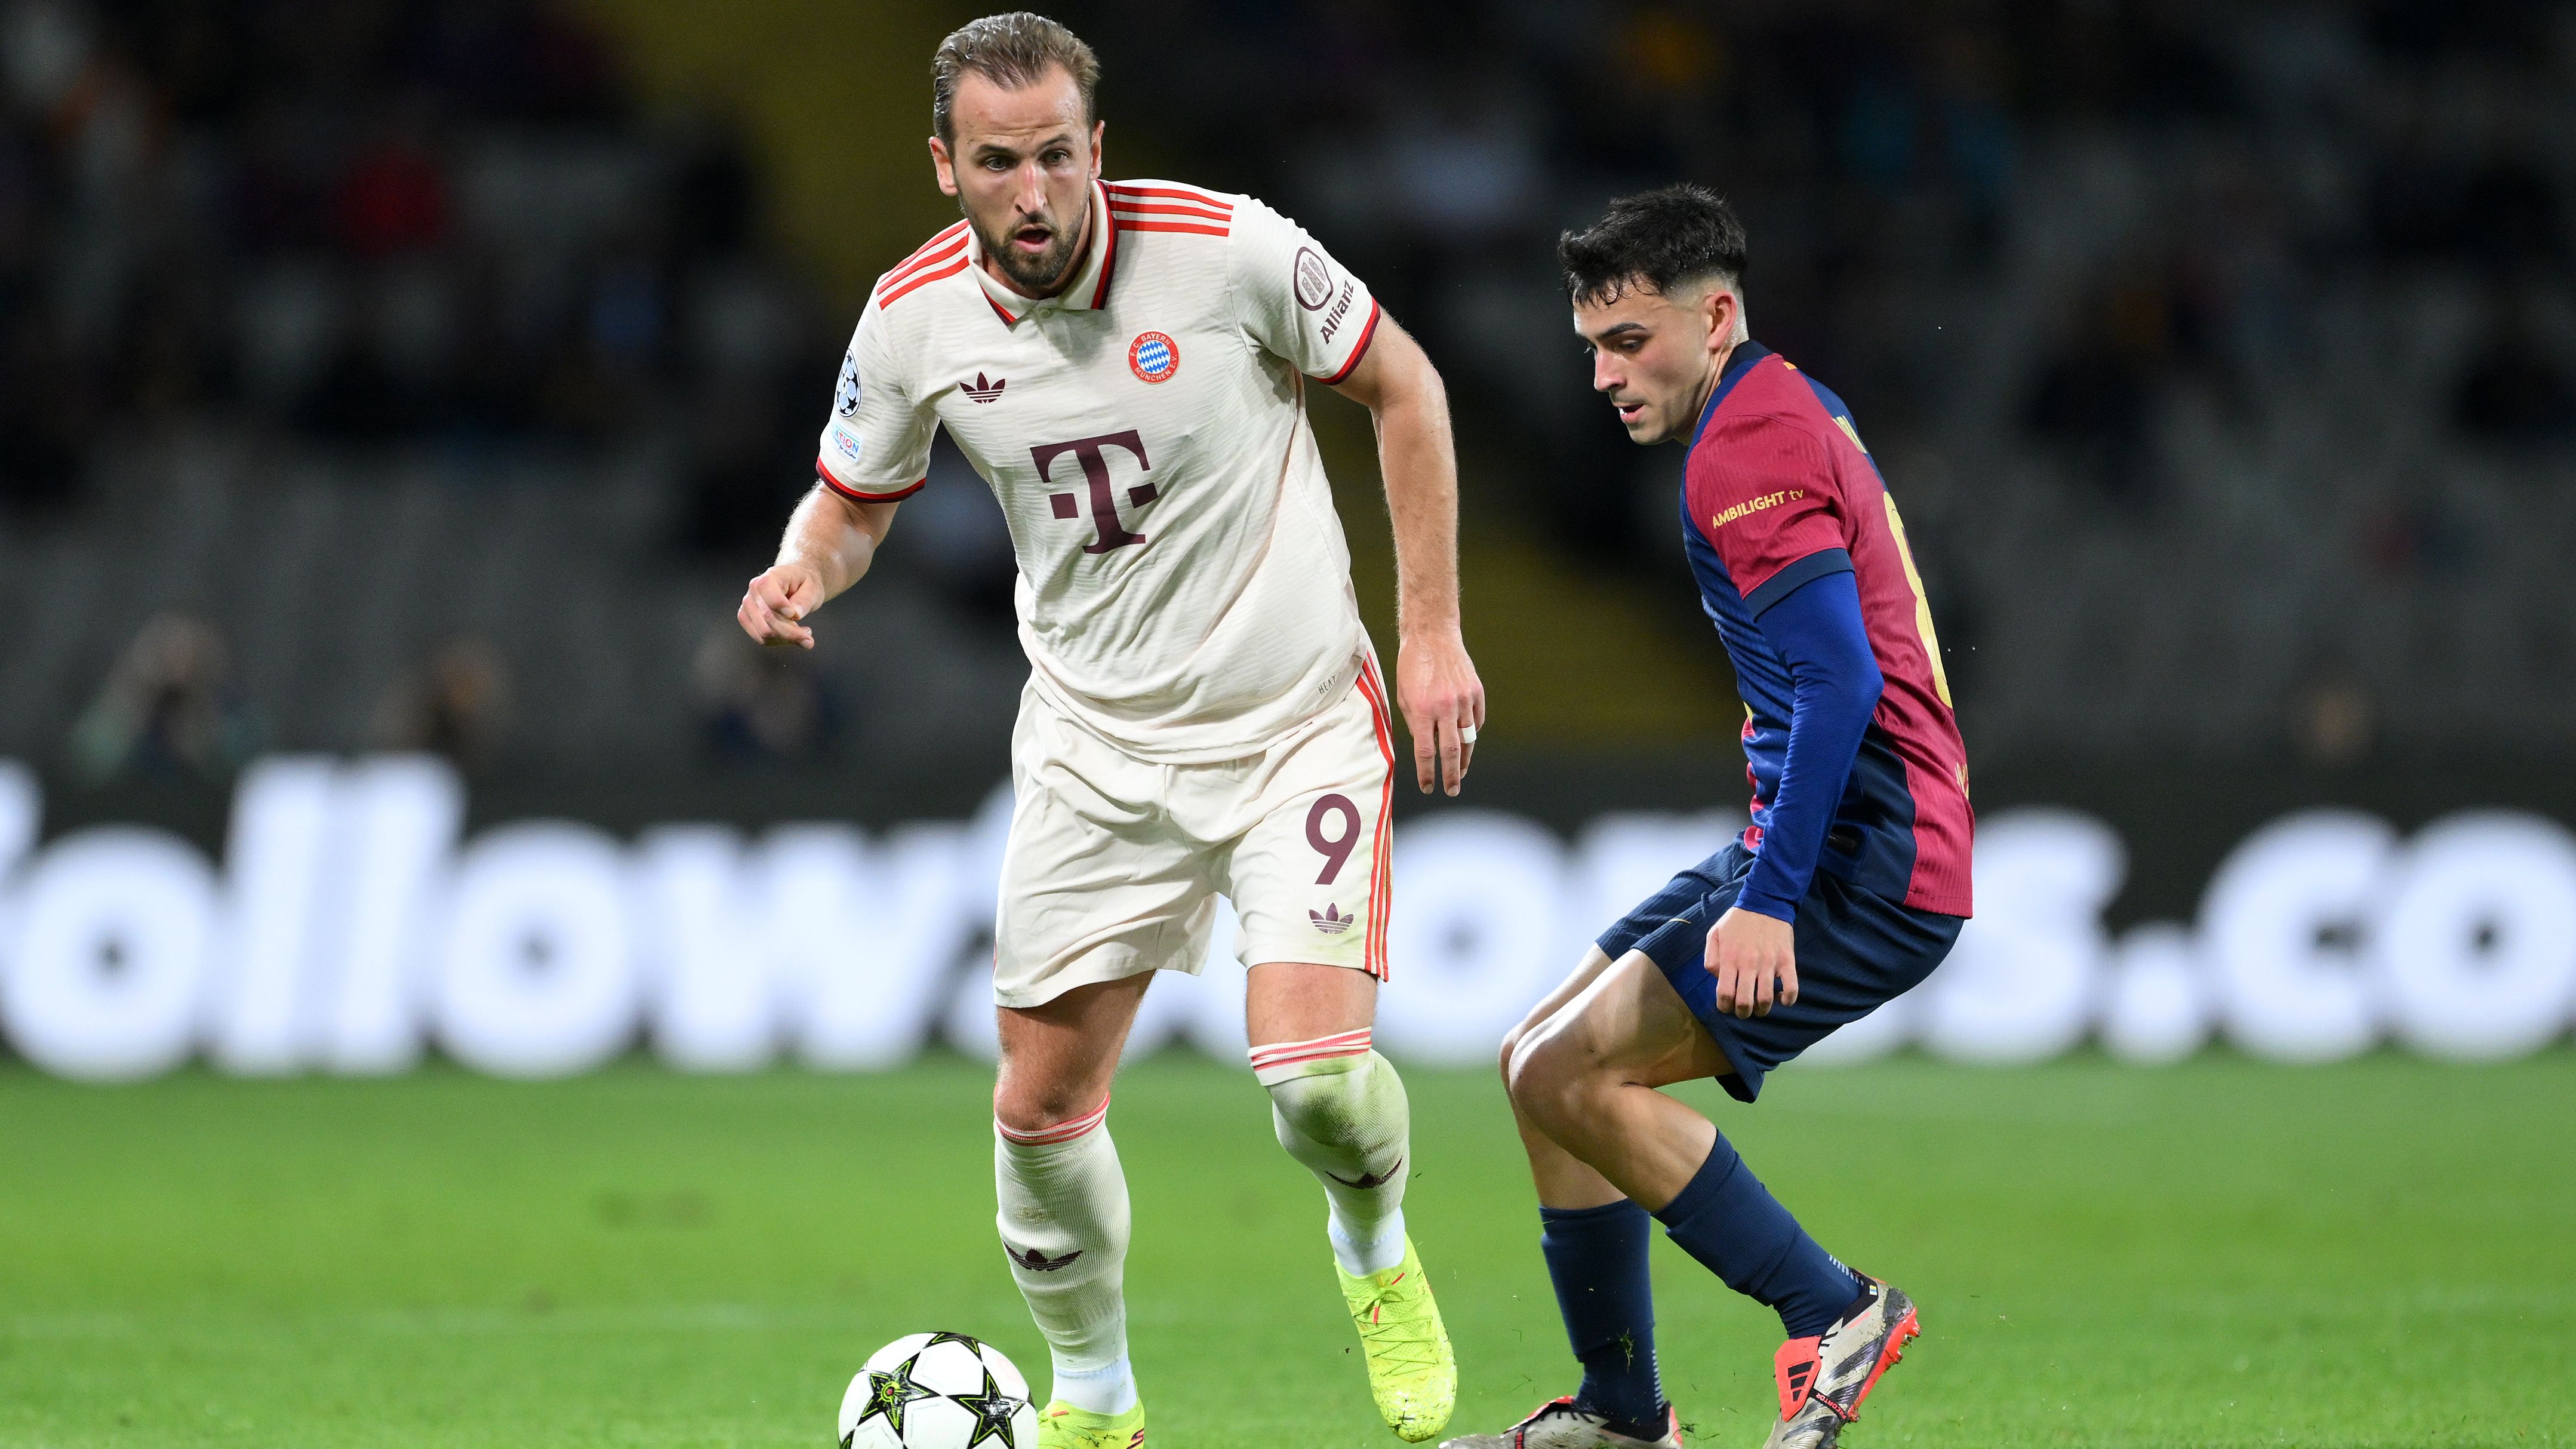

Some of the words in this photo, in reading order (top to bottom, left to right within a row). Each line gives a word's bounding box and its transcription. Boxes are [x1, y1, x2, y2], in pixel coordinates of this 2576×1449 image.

[1141, 333, 1171, 346] BAYERN
[1320, 279, 1354, 344] Allianz
[1030, 429, 1158, 555] T
[1712, 491, 1785, 530] AMBILIGHT
[1789, 490, 1803, 501] tv
[1305, 793, 1362, 885] 9
[0, 751, 979, 1082] ollow
[1815, 1392, 1847, 1420] PREDATOR
